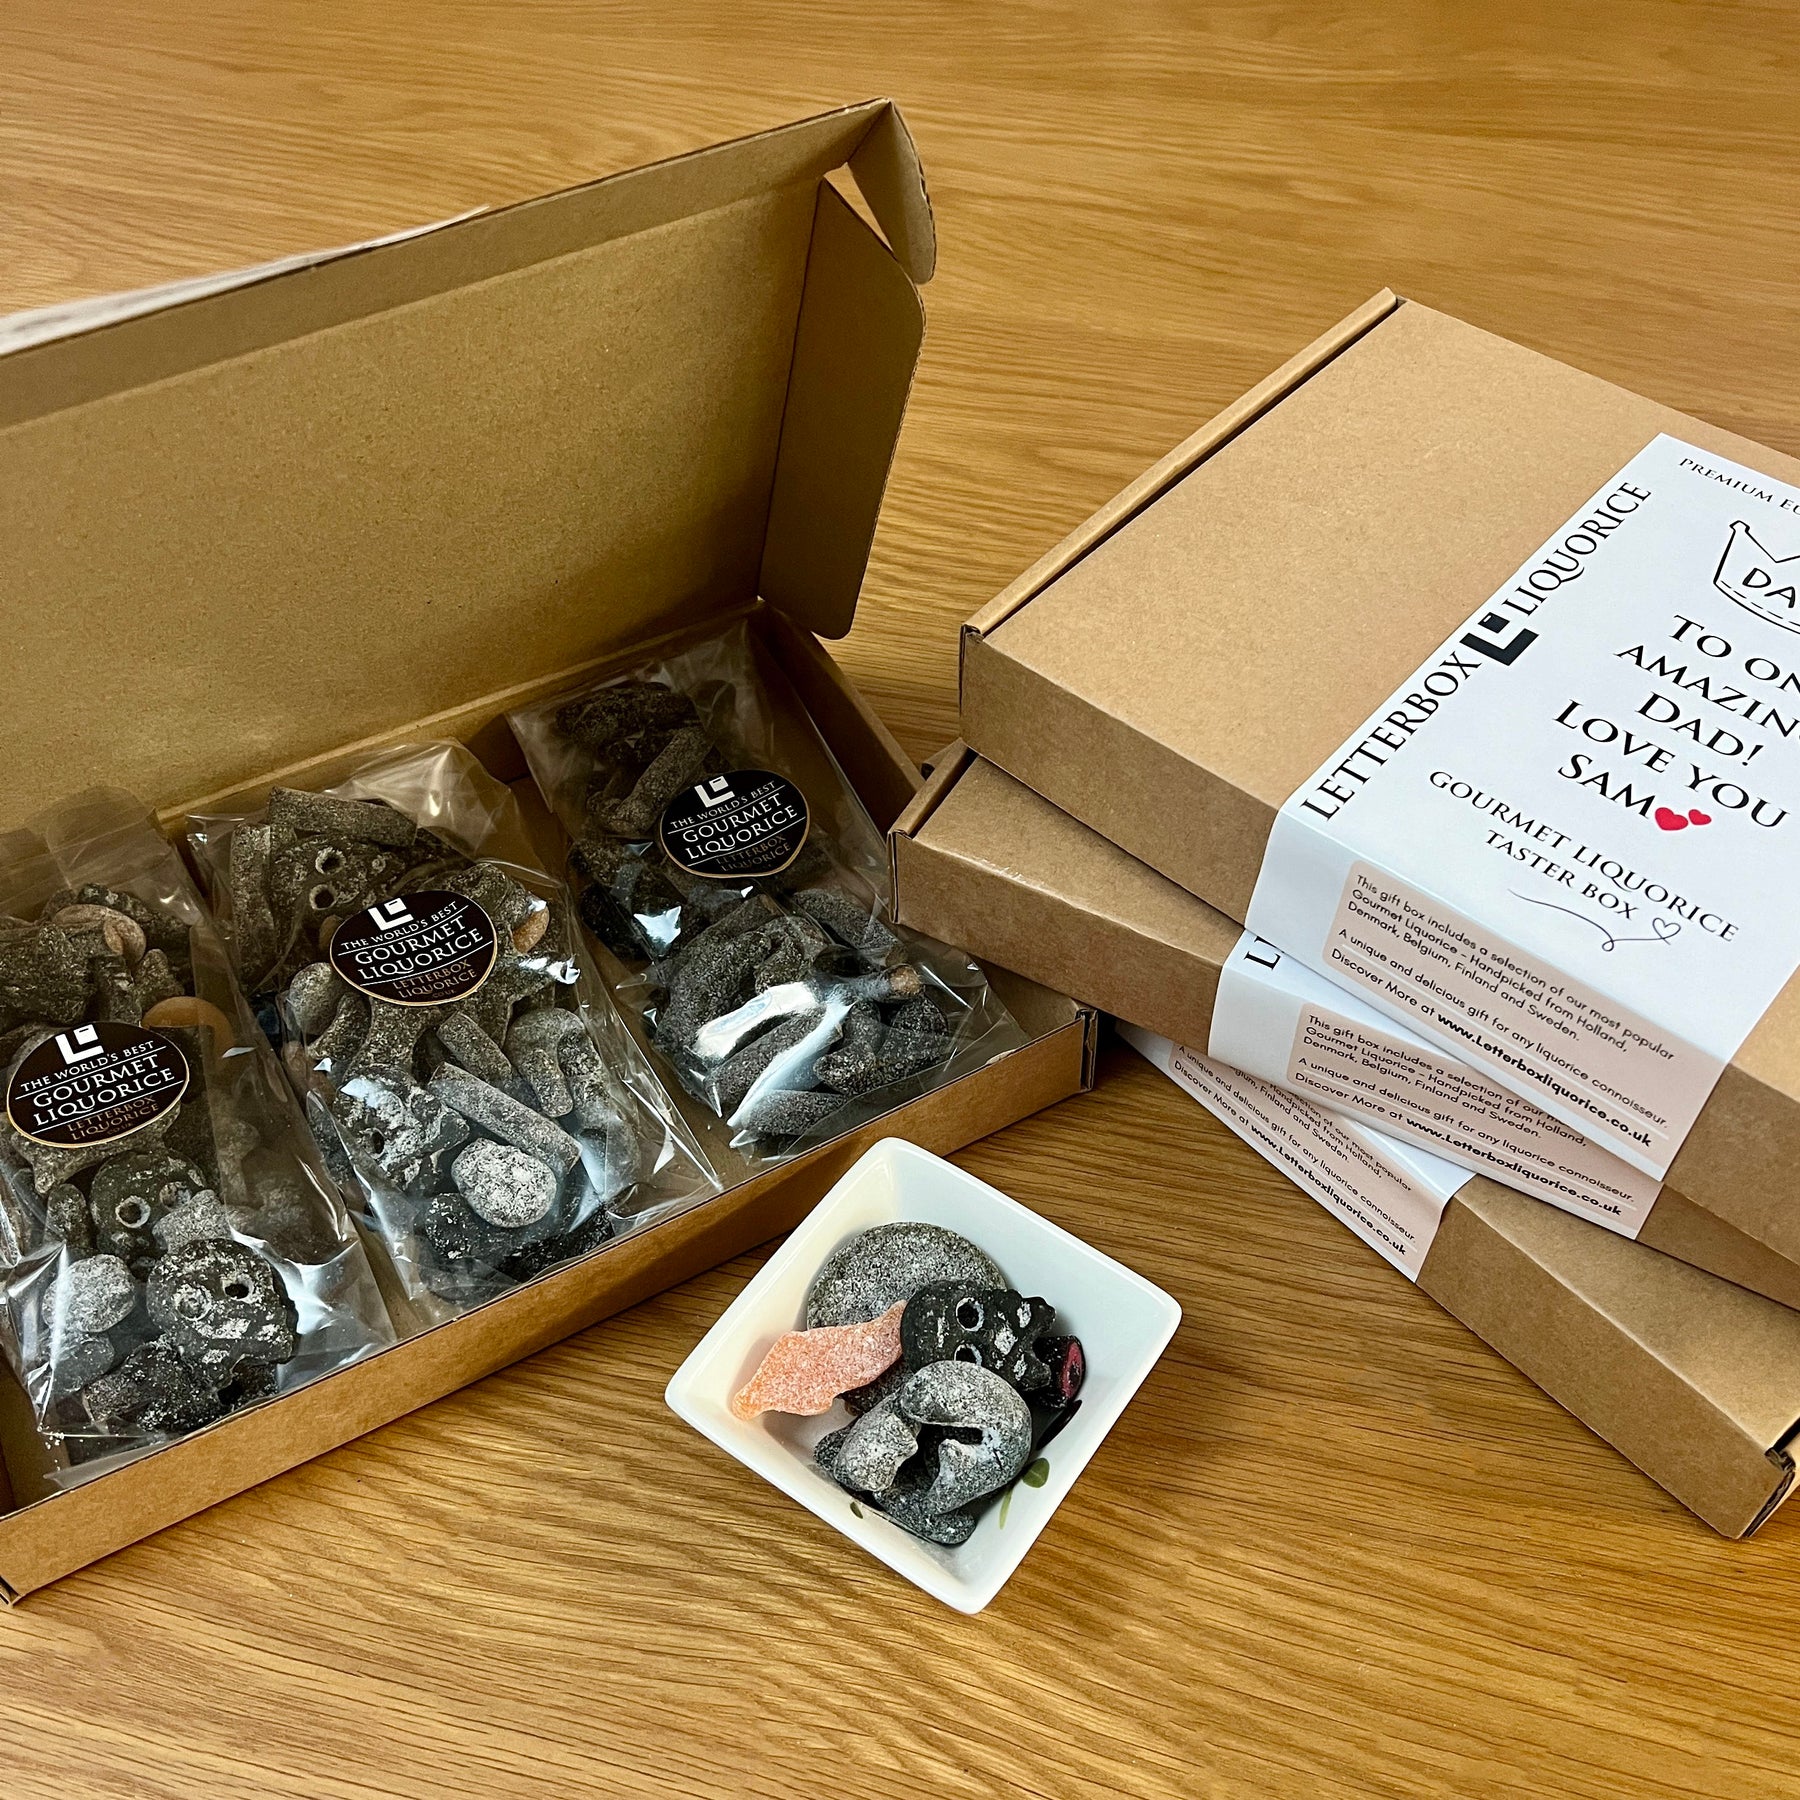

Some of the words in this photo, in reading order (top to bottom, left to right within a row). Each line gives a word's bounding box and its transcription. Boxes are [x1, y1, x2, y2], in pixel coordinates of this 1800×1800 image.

[1678, 458, 1773, 503] PREMIUM
[1501, 481, 1652, 616] LIQUORICE
[1742, 567, 1796, 609] DA
[1668, 614, 1732, 658] TO
[1613, 645, 1800, 740] AMAZIN
[1634, 691, 1764, 767] DAD!
[1300, 650, 1482, 821] LETTERBOX
[1553, 699, 1676, 774] LOVE
[1684, 763, 1790, 828] YOU
[670, 816, 696, 829] THE
[696, 796, 748, 821] WORLD'S
[750, 780, 776, 799] BEST
[682, 793, 782, 843] GOURMET
[1557, 754, 1656, 819] SAM
[685, 805, 798, 859] LIQUORICE
[716, 833, 786, 865] LETTERBOX
[721, 842, 791, 872] LIQUORICE
[1429, 770, 1572, 850] GOURMET
[1572, 843, 1740, 942] LIQUORICE
[1485, 829, 1575, 888] TASTER
[1581, 882, 1639, 920] BOX
[341, 938, 369, 950] THE
[371, 919, 428, 944] WORLD'S
[430, 901, 459, 922] BEST
[355, 915, 467, 964] GOURMET
[358, 928, 484, 980] LIQUORICE
[392, 958, 472, 990] LETTERBOX
[398, 968, 477, 999] LIQUORICE
[1348, 901, 1400, 938] Denmark,
[1403, 932, 1450, 968] Belgium,
[1454, 962, 1499, 993] Finland
[1501, 990, 1526, 1008] and
[1527, 1004, 1580, 1041] Sweden.
[1352, 890, 1402, 922] Gourmet
[1404, 918, 1458, 954] Liquorice
[1470, 954, 1542, 1002] Handpicked
[1545, 997, 1574, 1020] from
[1576, 1015, 1628, 1052] Holland,
[1358, 875, 1376, 894] This
[1380, 891, 1400, 906] gift
[1404, 902, 1424, 920] box
[1428, 916, 1476, 950] includes
[1491, 953, 1546, 988] selection
[1550, 986, 1564, 996] of
[1566, 995, 1588, 1010] our
[1589, 1008, 1620, 1030] most
[1622, 1028, 1675, 1061] popular
[20, 1076, 52, 1092] THE
[54, 1053, 118, 1080] WORLD'S
[122, 1040, 154, 1058] BEST
[1309, 1015, 1330, 1030] This
[1334, 1027, 1354, 1039] gift
[1358, 1034, 1380, 1050] box
[1382, 1046, 1432, 1070] includes
[1448, 1073, 1502, 1100] selection
[1506, 1098, 1520, 1106] of
[1522, 1104, 1544, 1116] our
[1332, 948, 1384, 985] Discover
[1385, 980, 1418, 1006] More
[1420, 1004, 1436, 1016] at
[1438, 1014, 1652, 1147] www.Letterboxliquorice.co.uk
[1338, 928, 1347, 938] A
[1350, 935, 1388, 962] unique
[1390, 959, 1413, 976] and
[1415, 974, 1465, 1008] delicious
[1467, 1006, 1489, 1022] gift
[1492, 1018, 1510, 1033] for
[1512, 1032, 1534, 1050] any
[1536, 1042, 1589, 1080] liquorice
[1592, 1078, 1668, 1128] connoisseur.
[33, 1054, 159, 1108] GOURMET
[34, 1068, 175, 1126] LIQUORICE
[68, 1096, 156, 1132] LETTERBOX
[1231, 1067, 1258, 1089] gium,
[1260, 1086, 1292, 1114] Finland
[1293, 1114, 1310, 1130] and
[1312, 1128, 1349, 1163] Sweden.
[1304, 1036, 1358, 1063] Denmark,
[1362, 1060, 1411, 1084] Belgium,
[1414, 1080, 1459, 1102] Finland
[1462, 1101, 1486, 1114] and
[1489, 1111, 1541, 1138] Sweden.
[1306, 1026, 1358, 1052] Gourmet
[1361, 1048, 1415, 1074] Liquorice
[1428, 1074, 1500, 1110] Handpicked
[1504, 1107, 1532, 1124] from
[1536, 1120, 1588, 1146] Holland,
[71, 1104, 159, 1140] LIQUORICE
[1174, 1060, 1212, 1095] Discover
[1213, 1093, 1237, 1116] More
[1239, 1116, 1248, 1126] at
[1251, 1125, 1406, 1255] www.Letterboxliquorice.co.uk
[1179, 1046, 1185, 1054] A
[1187, 1053, 1214, 1077] unique
[1216, 1076, 1232, 1092] and
[1234, 1091, 1270, 1123] delicious
[1271, 1122, 1286, 1136] gift
[1289, 1135, 1301, 1148] for
[1303, 1148, 1318, 1164] any
[1320, 1160, 1358, 1196] liquorice
[1360, 1195, 1416, 1243] connoisseur.
[1270, 1083, 1320, 1128] Handpicked
[1324, 1126, 1343, 1146] from
[1346, 1145, 1382, 1178] Holland,
[1295, 1072, 1350, 1099] Discover
[1352, 1095, 1386, 1113] More
[1390, 1110, 1403, 1120] at
[1406, 1118, 1622, 1216] www.Letterboxliquorice.co.uk
[1310, 1062, 1349, 1081] unique
[1352, 1078, 1376, 1091] and
[1379, 1088, 1431, 1114] delicious
[1433, 1112, 1454, 1125] gift
[1458, 1120, 1475, 1132] for
[1478, 1132, 1500, 1145] any
[1502, 1140, 1555, 1167] liquorice
[1558, 1165, 1634, 1202] connoisseur.
[1324, 1118, 1332, 1127] of
[1336, 1128, 1350, 1140] our
[1352, 1142, 1374, 1160] most
[1376, 1161, 1412, 1191] popular
